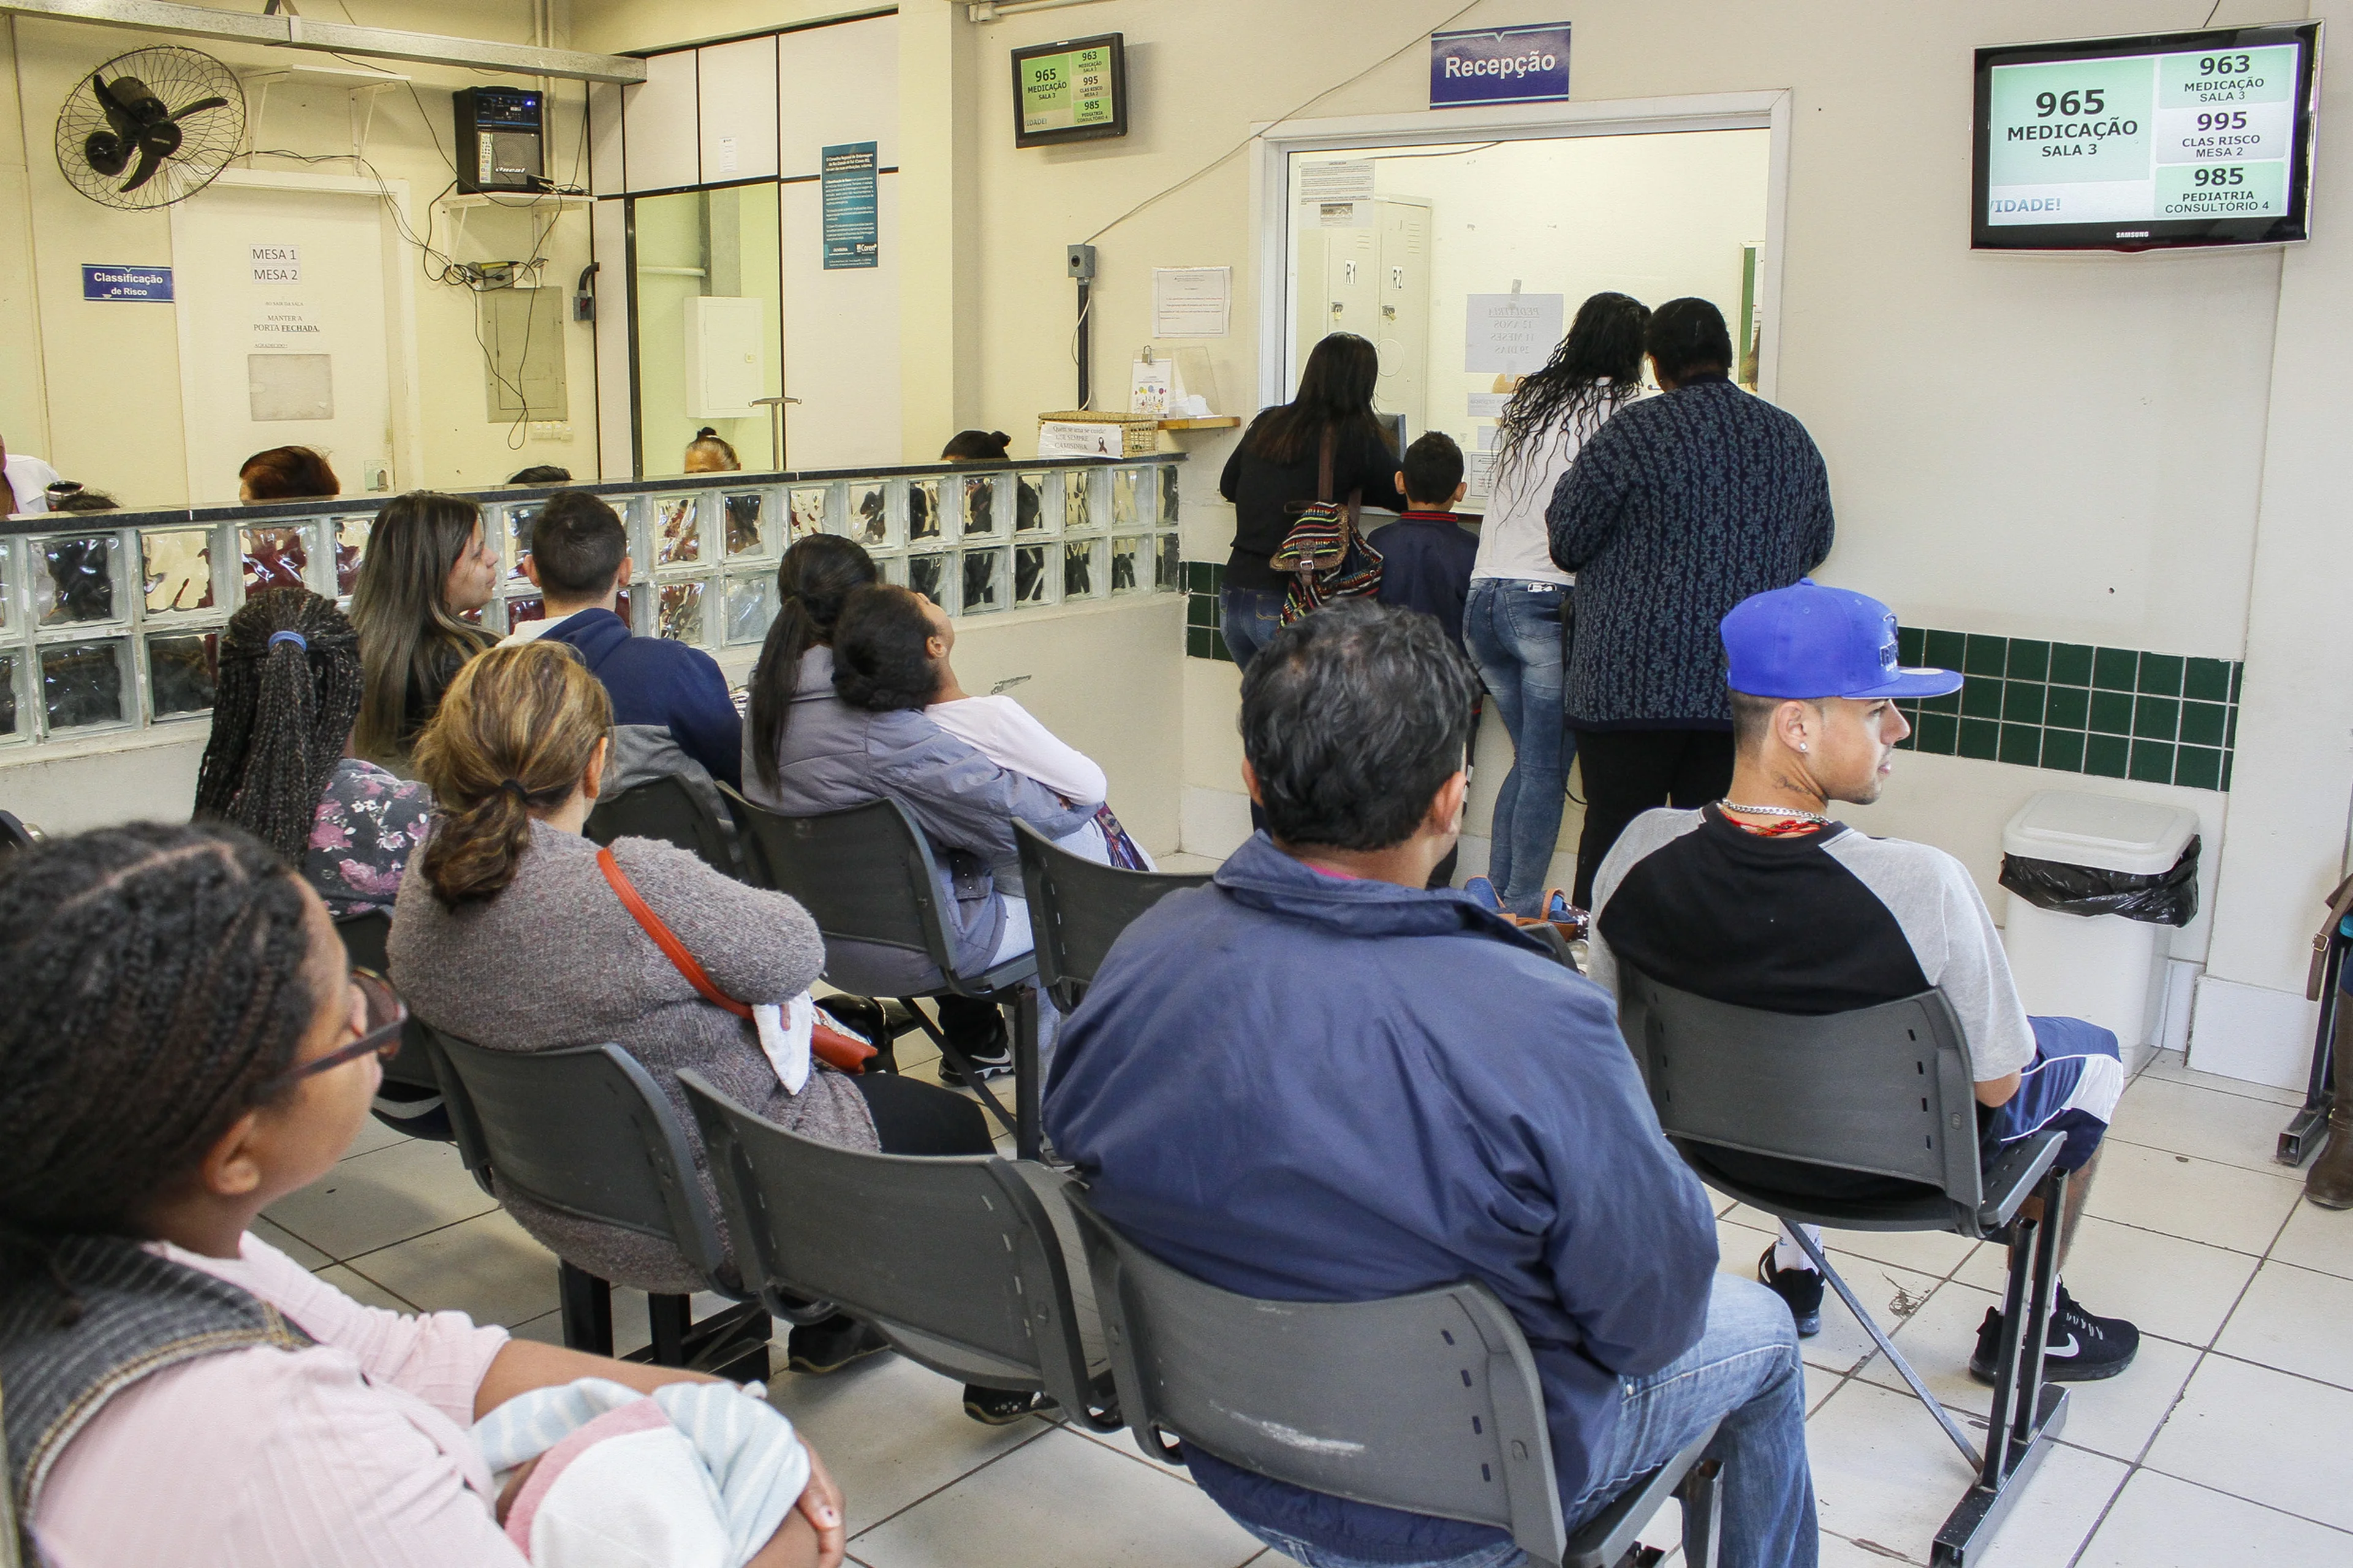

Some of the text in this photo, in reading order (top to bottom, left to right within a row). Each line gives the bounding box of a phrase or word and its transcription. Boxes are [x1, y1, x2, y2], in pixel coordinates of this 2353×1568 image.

[1082, 51, 1097, 61] 963
[1445, 50, 1556, 80] Recepção
[2200, 55, 2250, 76] 963
[1036, 68, 1056, 82] 965
[1083, 75, 1098, 86] 995
[1028, 80, 1067, 93] MEDICAÇÃO
[2184, 77, 2264, 92] MEDICAÇÃO
[2200, 91, 2246, 102] SALA 3
[1085, 100, 1099, 110] 985
[2036, 89, 2105, 118] 965
[2197, 111, 2247, 131] 995
[2007, 116, 2138, 141] MEDICAÇÃO
[2182, 135, 2260, 147] CLAS RISCO
[2042, 143, 2097, 157] SALA 3
[2196, 147, 2243, 157] MESA 2
[2194, 167, 2244, 187] 985
[2182, 191, 2254, 202] PEDIATRIA
[2165, 201, 2269, 213] CONSULTÓRIO 4
[252, 249, 297, 260] MESA 1
[94, 272, 163, 285] Classificação
[254, 269, 298, 280] MESA 2
[1346, 263, 1355, 284] R1
[1393, 269, 1402, 289] R2
[123, 287, 148, 296] Risco
